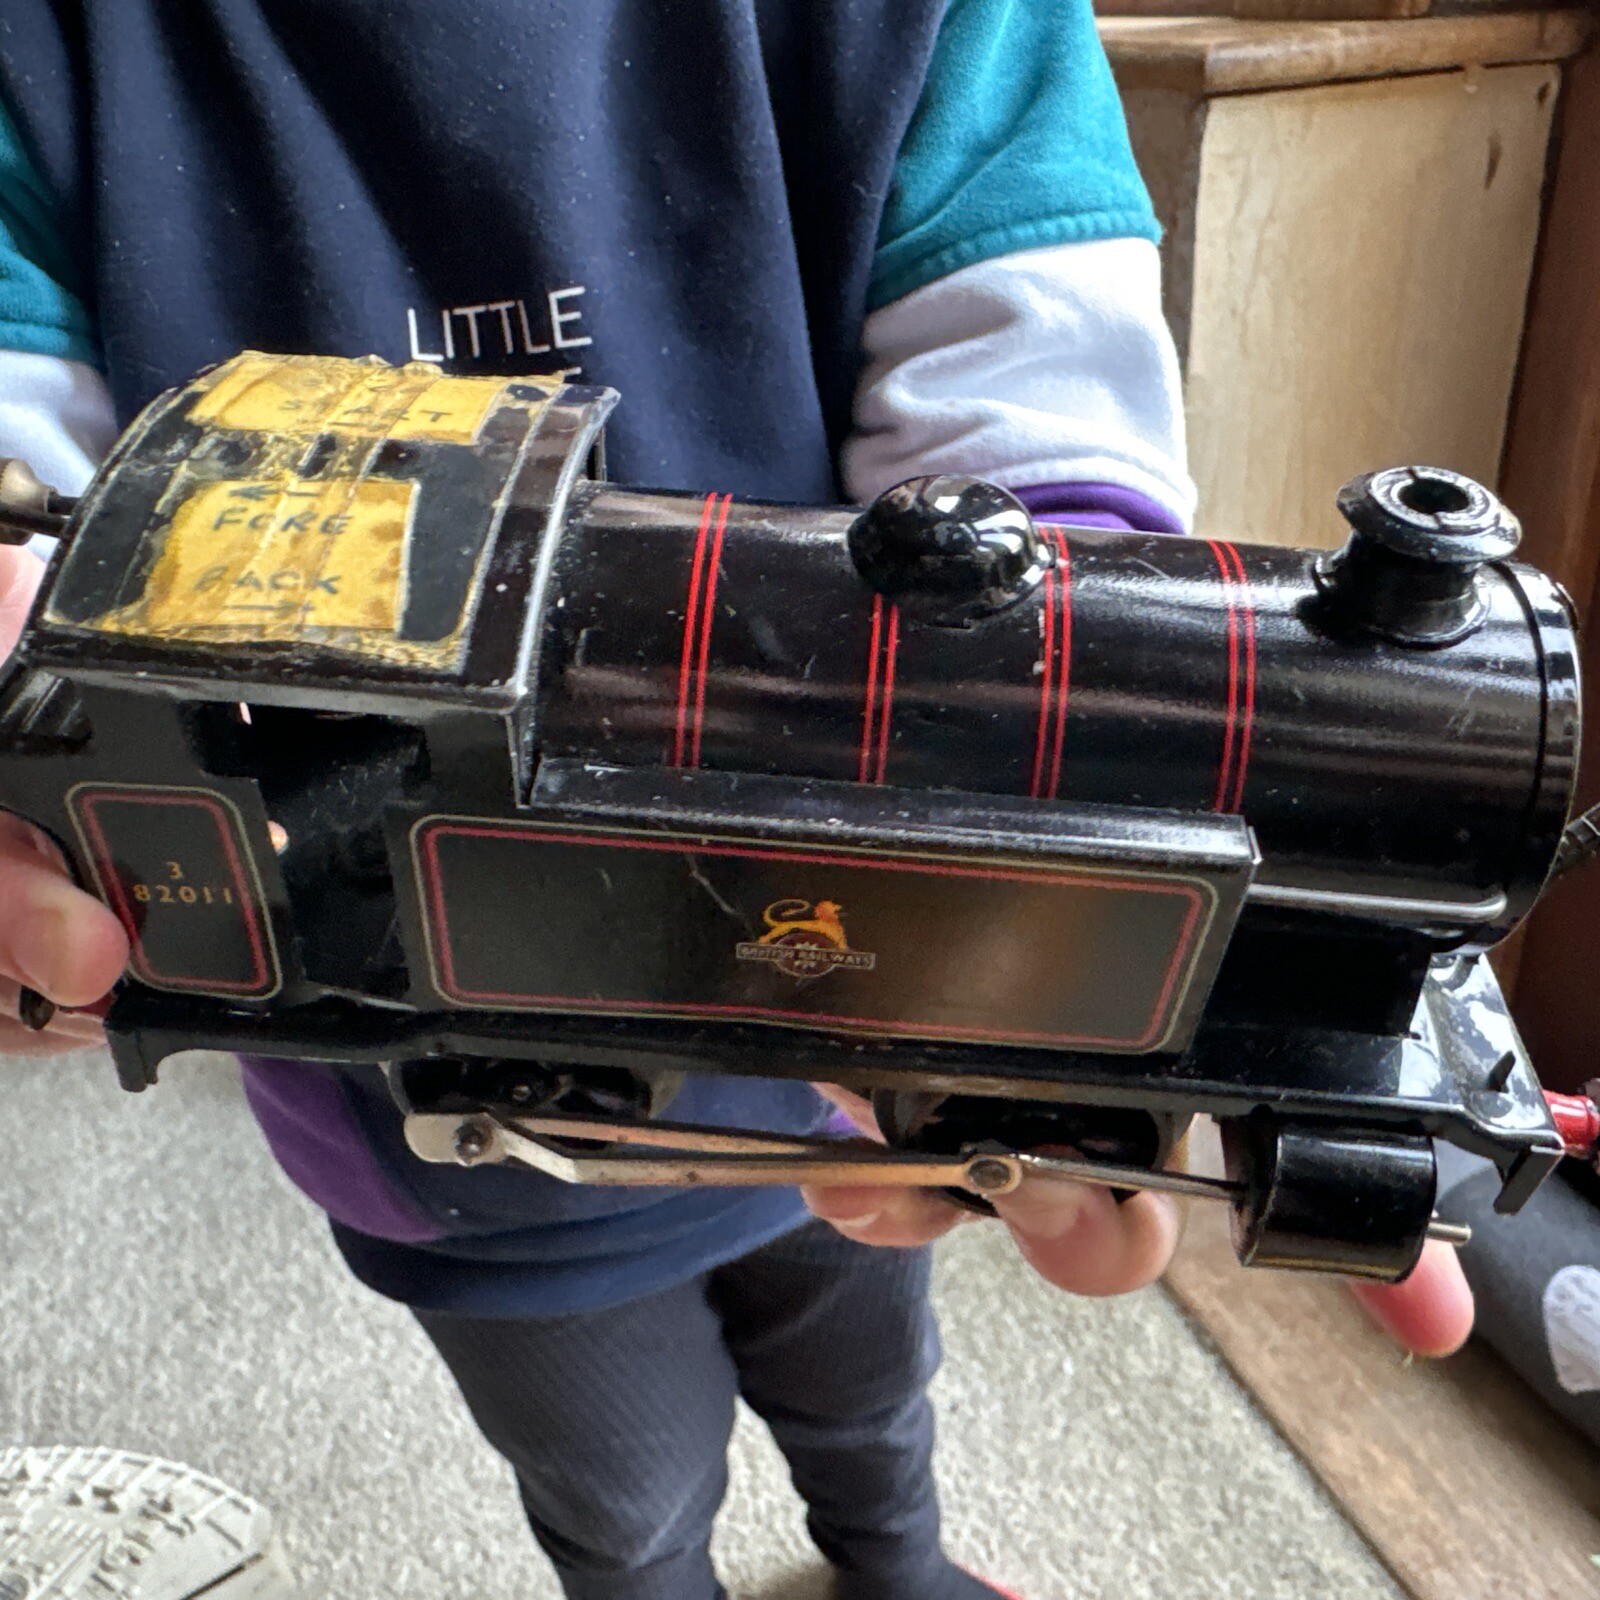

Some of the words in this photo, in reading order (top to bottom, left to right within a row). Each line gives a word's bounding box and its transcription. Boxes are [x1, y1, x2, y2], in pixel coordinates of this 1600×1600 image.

[406, 285, 593, 363] LITTLE
[211, 505, 354, 535] FORE
[191, 563, 342, 595] BACK
[166, 861, 184, 880] 3
[132, 883, 233, 904] 82011
